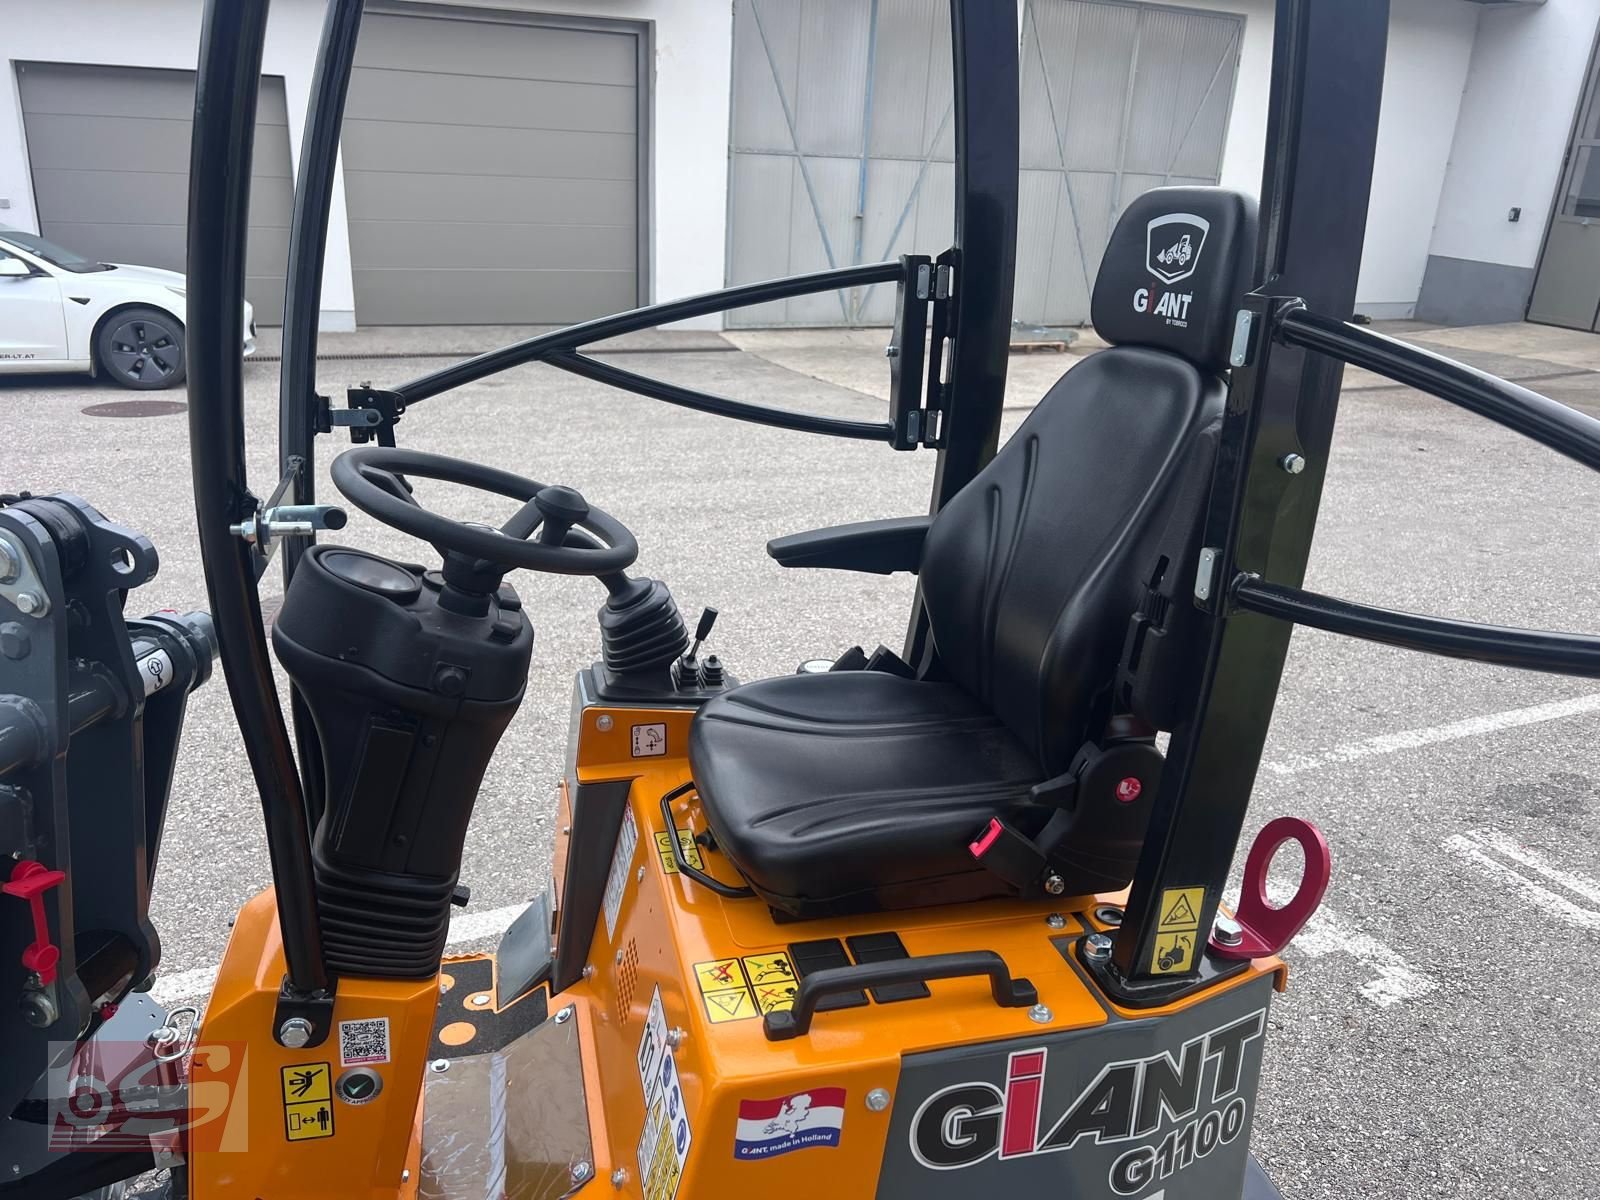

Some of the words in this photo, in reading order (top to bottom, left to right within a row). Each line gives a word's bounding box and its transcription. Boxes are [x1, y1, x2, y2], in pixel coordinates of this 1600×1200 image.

[769, 1141, 791, 1152] made
[792, 1138, 800, 1146] in
[801, 1134, 832, 1143] Holland
[1109, 1098, 1246, 1196] G1100
